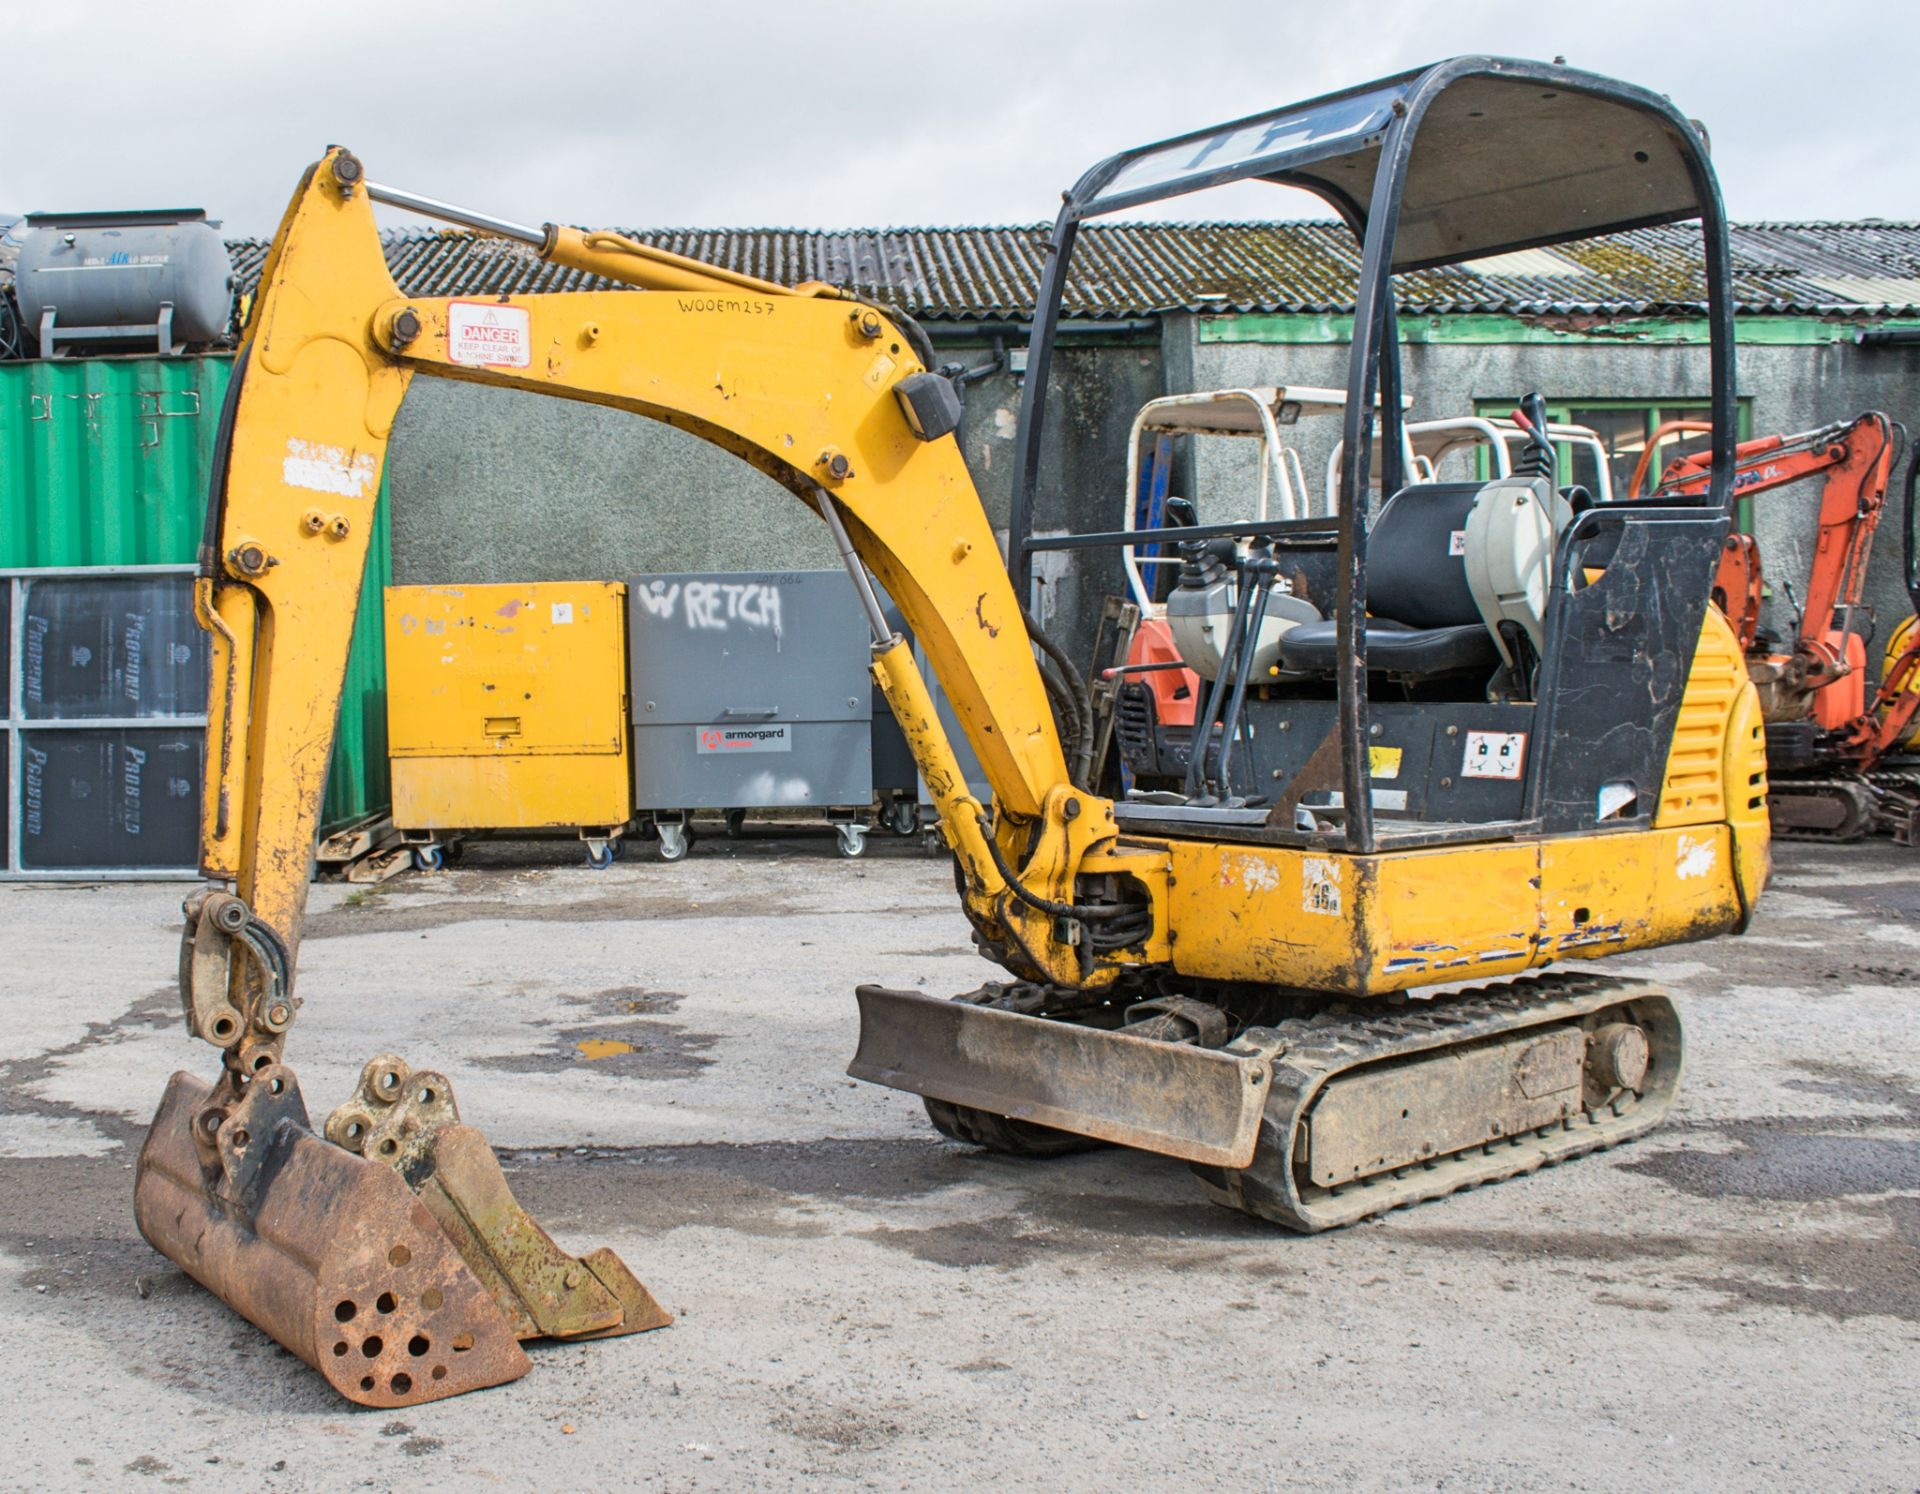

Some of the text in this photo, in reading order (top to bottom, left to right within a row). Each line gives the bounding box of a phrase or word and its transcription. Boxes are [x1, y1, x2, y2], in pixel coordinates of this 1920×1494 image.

[464, 326, 518, 343] DANGER
[458, 342, 480, 351] KEEP
[482, 343, 508, 352] CLEAR
[638, 580, 783, 630] WRETCH
[725, 728, 784, 740] armorgard
